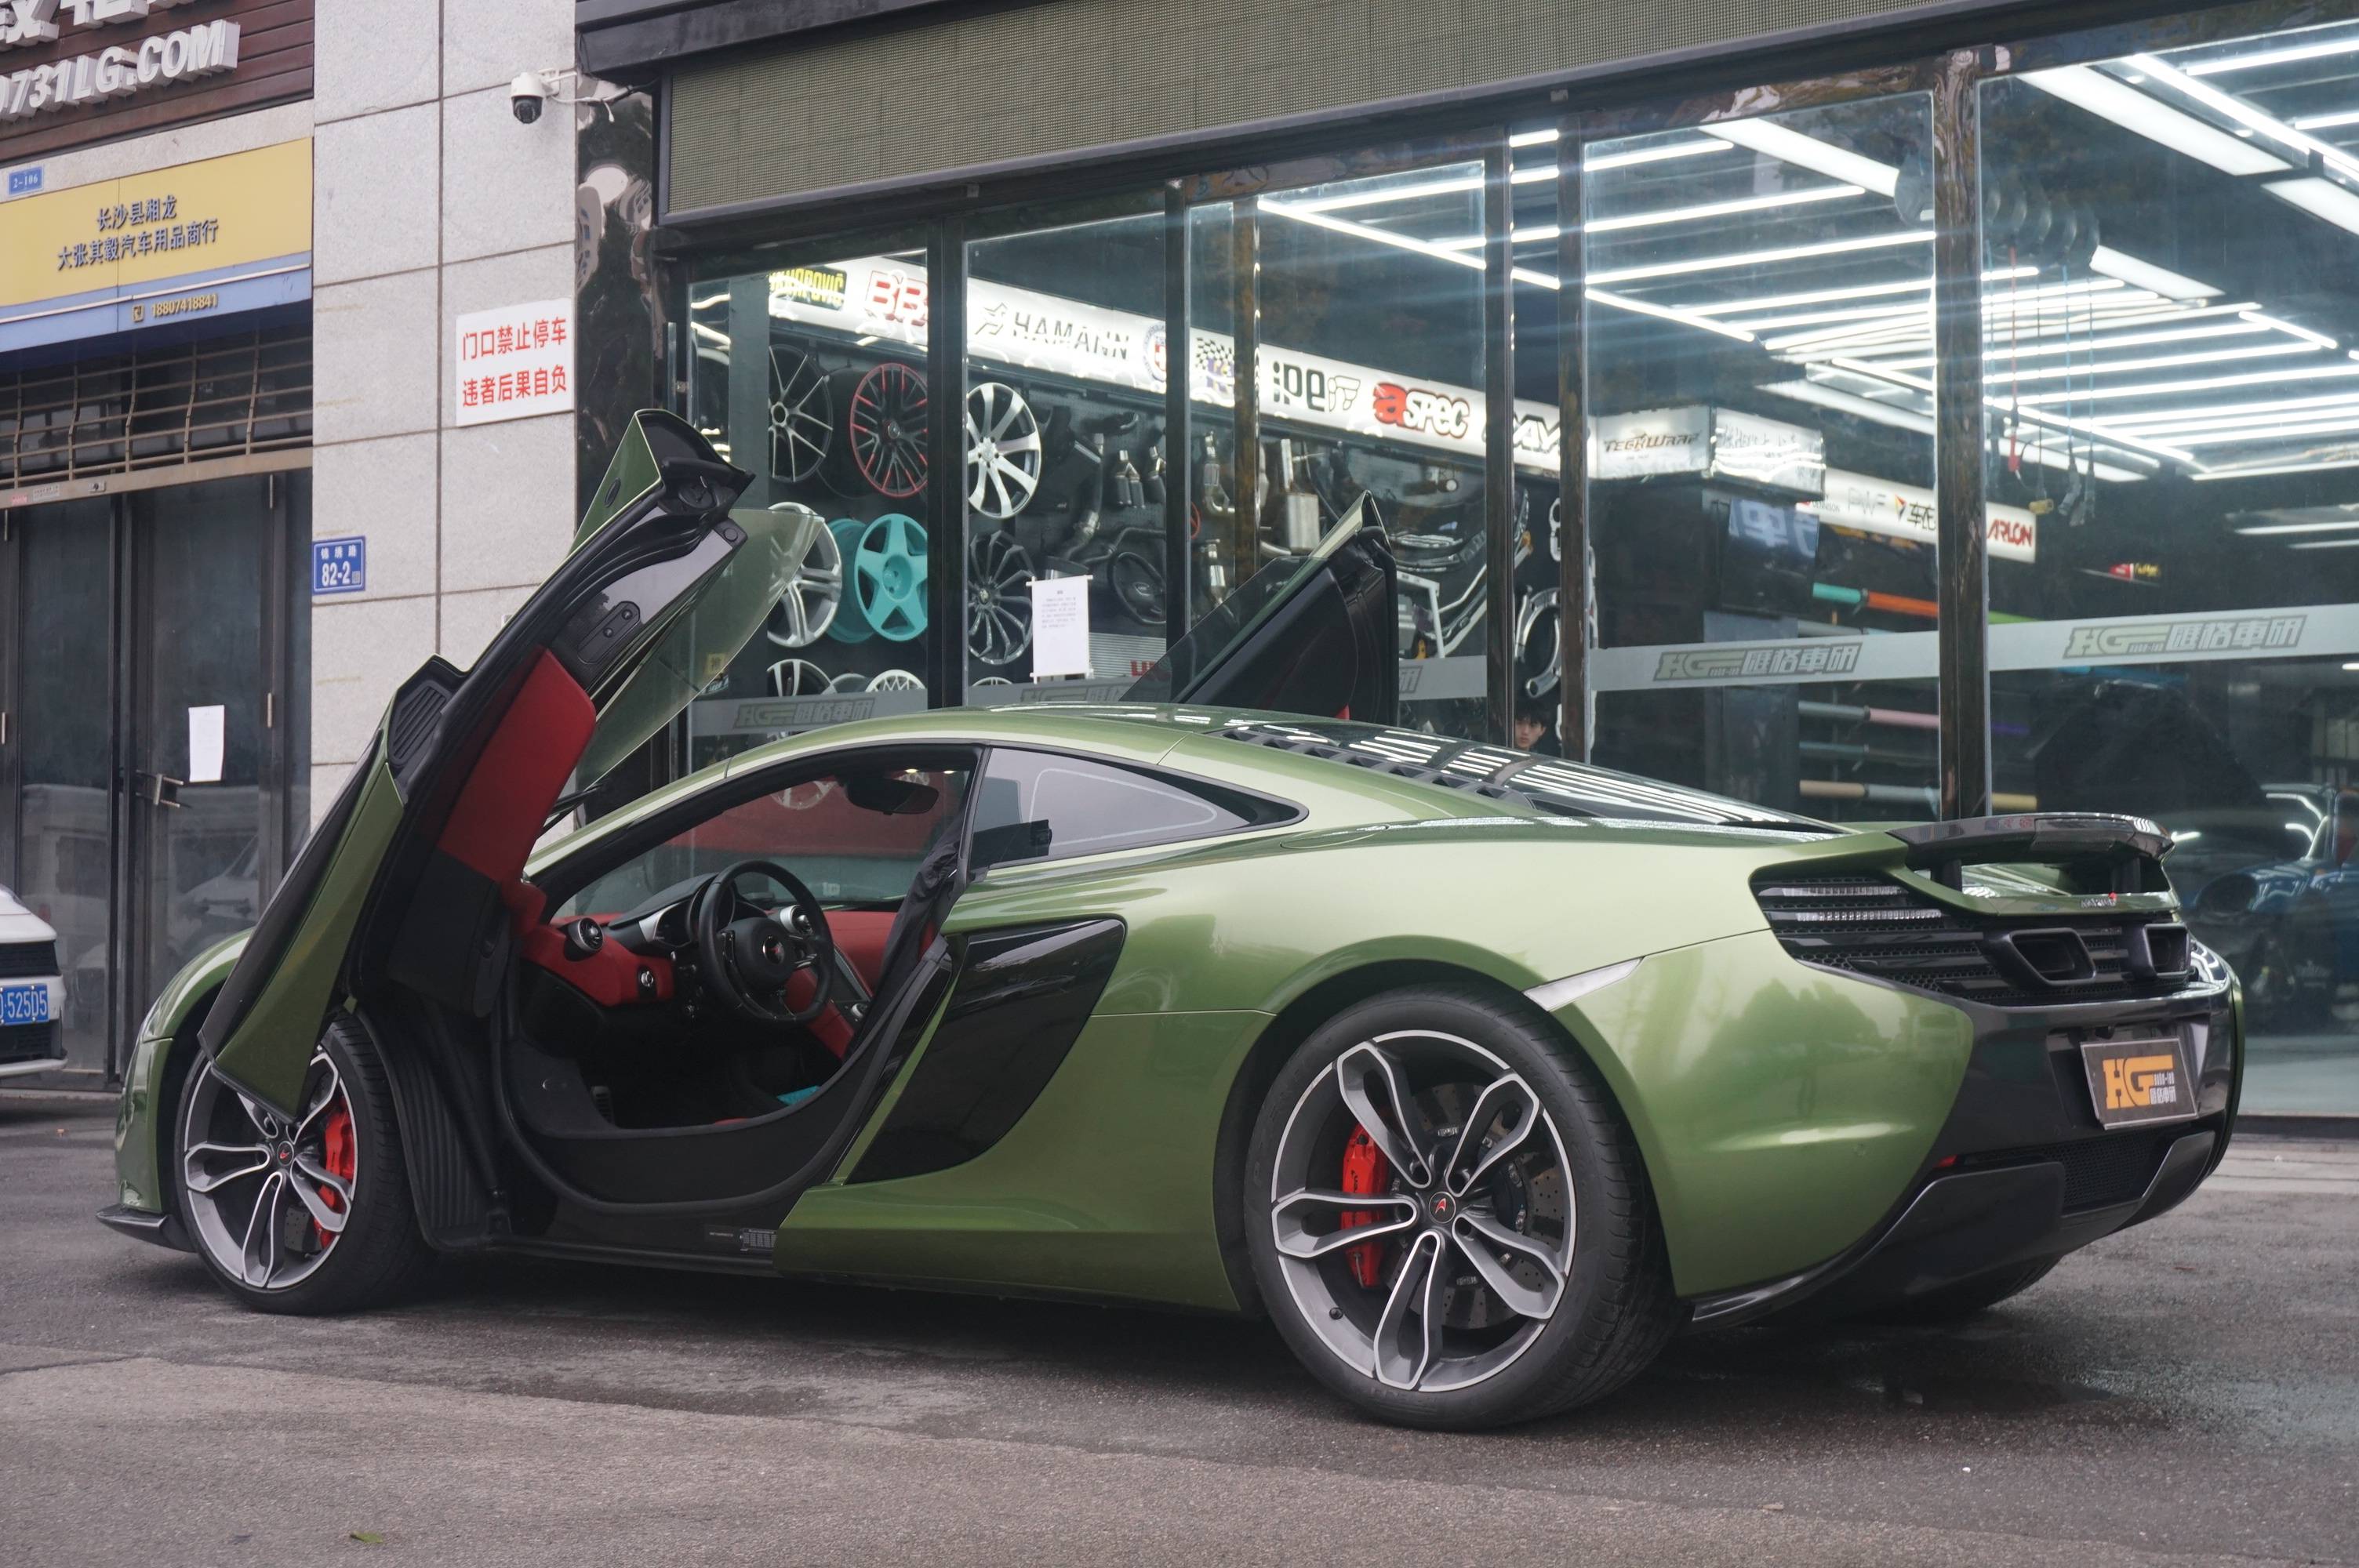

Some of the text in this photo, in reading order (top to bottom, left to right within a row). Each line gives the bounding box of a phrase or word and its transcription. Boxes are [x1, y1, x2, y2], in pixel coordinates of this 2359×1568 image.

[97, 194, 177, 232] 长沙县湘龙
[865, 270, 928, 327] BB
[462, 317, 567, 361] 门口禁止停车
[463, 364, 566, 407] 违者后果自负
[1986, 519, 2033, 547] ARLON
[322, 561, 351, 587] 82-2
